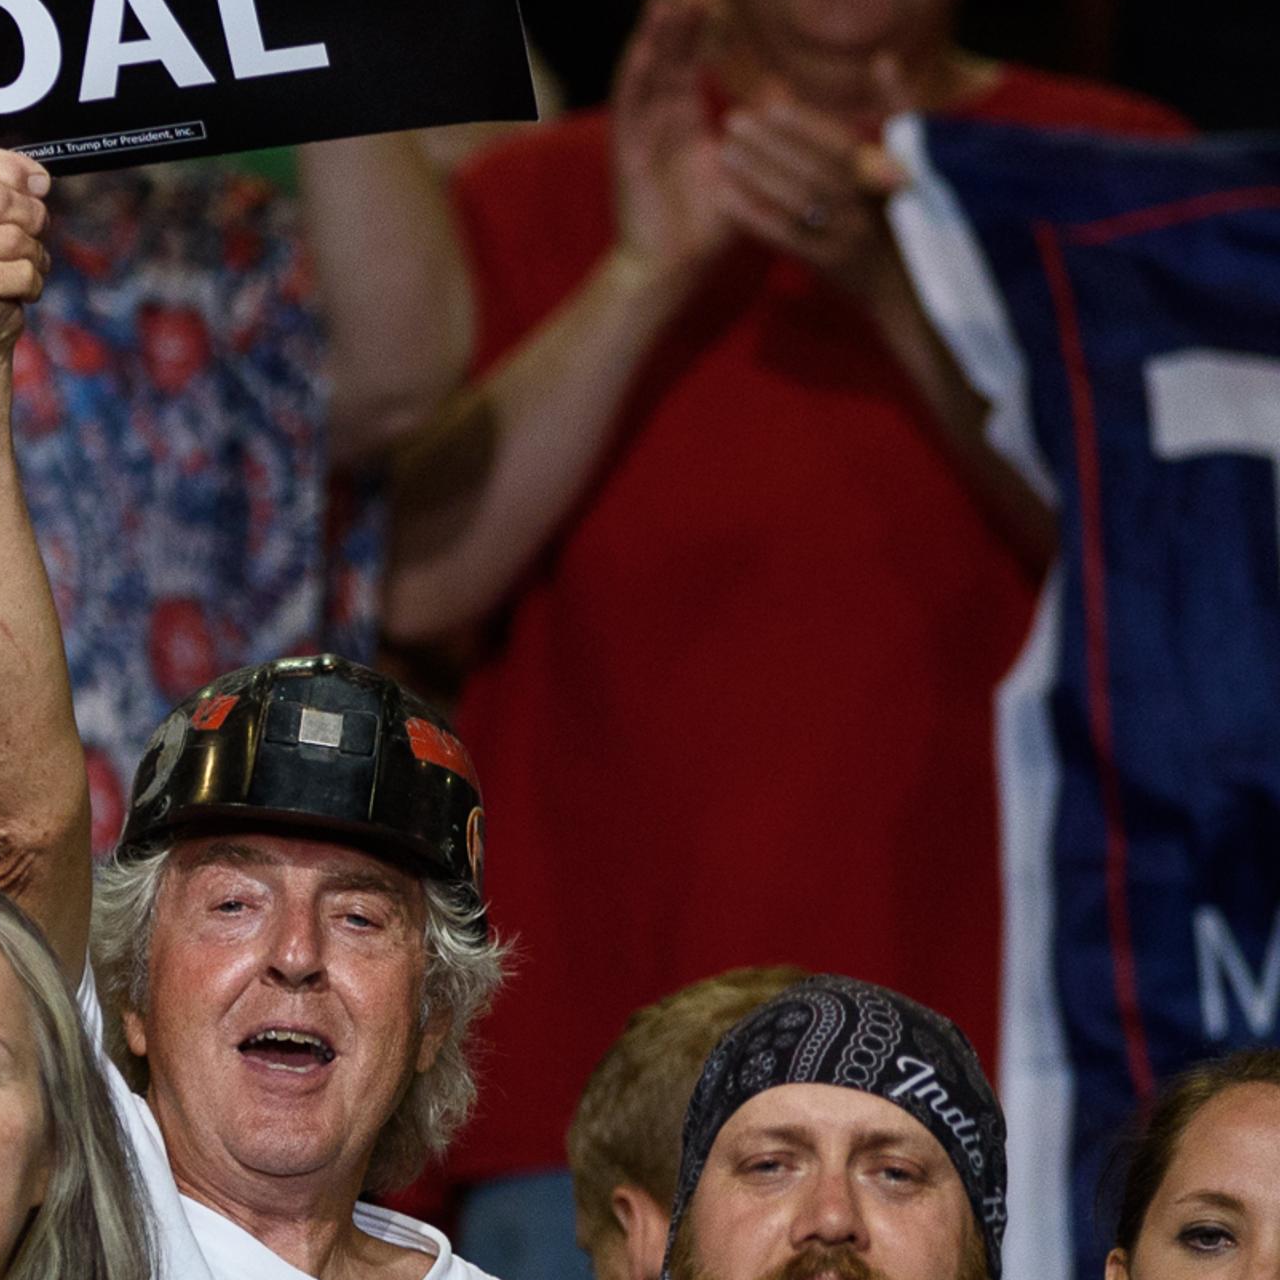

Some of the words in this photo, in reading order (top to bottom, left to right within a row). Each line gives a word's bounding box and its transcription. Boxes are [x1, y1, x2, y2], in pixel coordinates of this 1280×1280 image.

[65, 139, 101, 154] Trump
[102, 137, 119, 149] for
[119, 128, 174, 146] President,
[174, 126, 195, 138] Inc.
[889, 1054, 985, 1177] Indie
